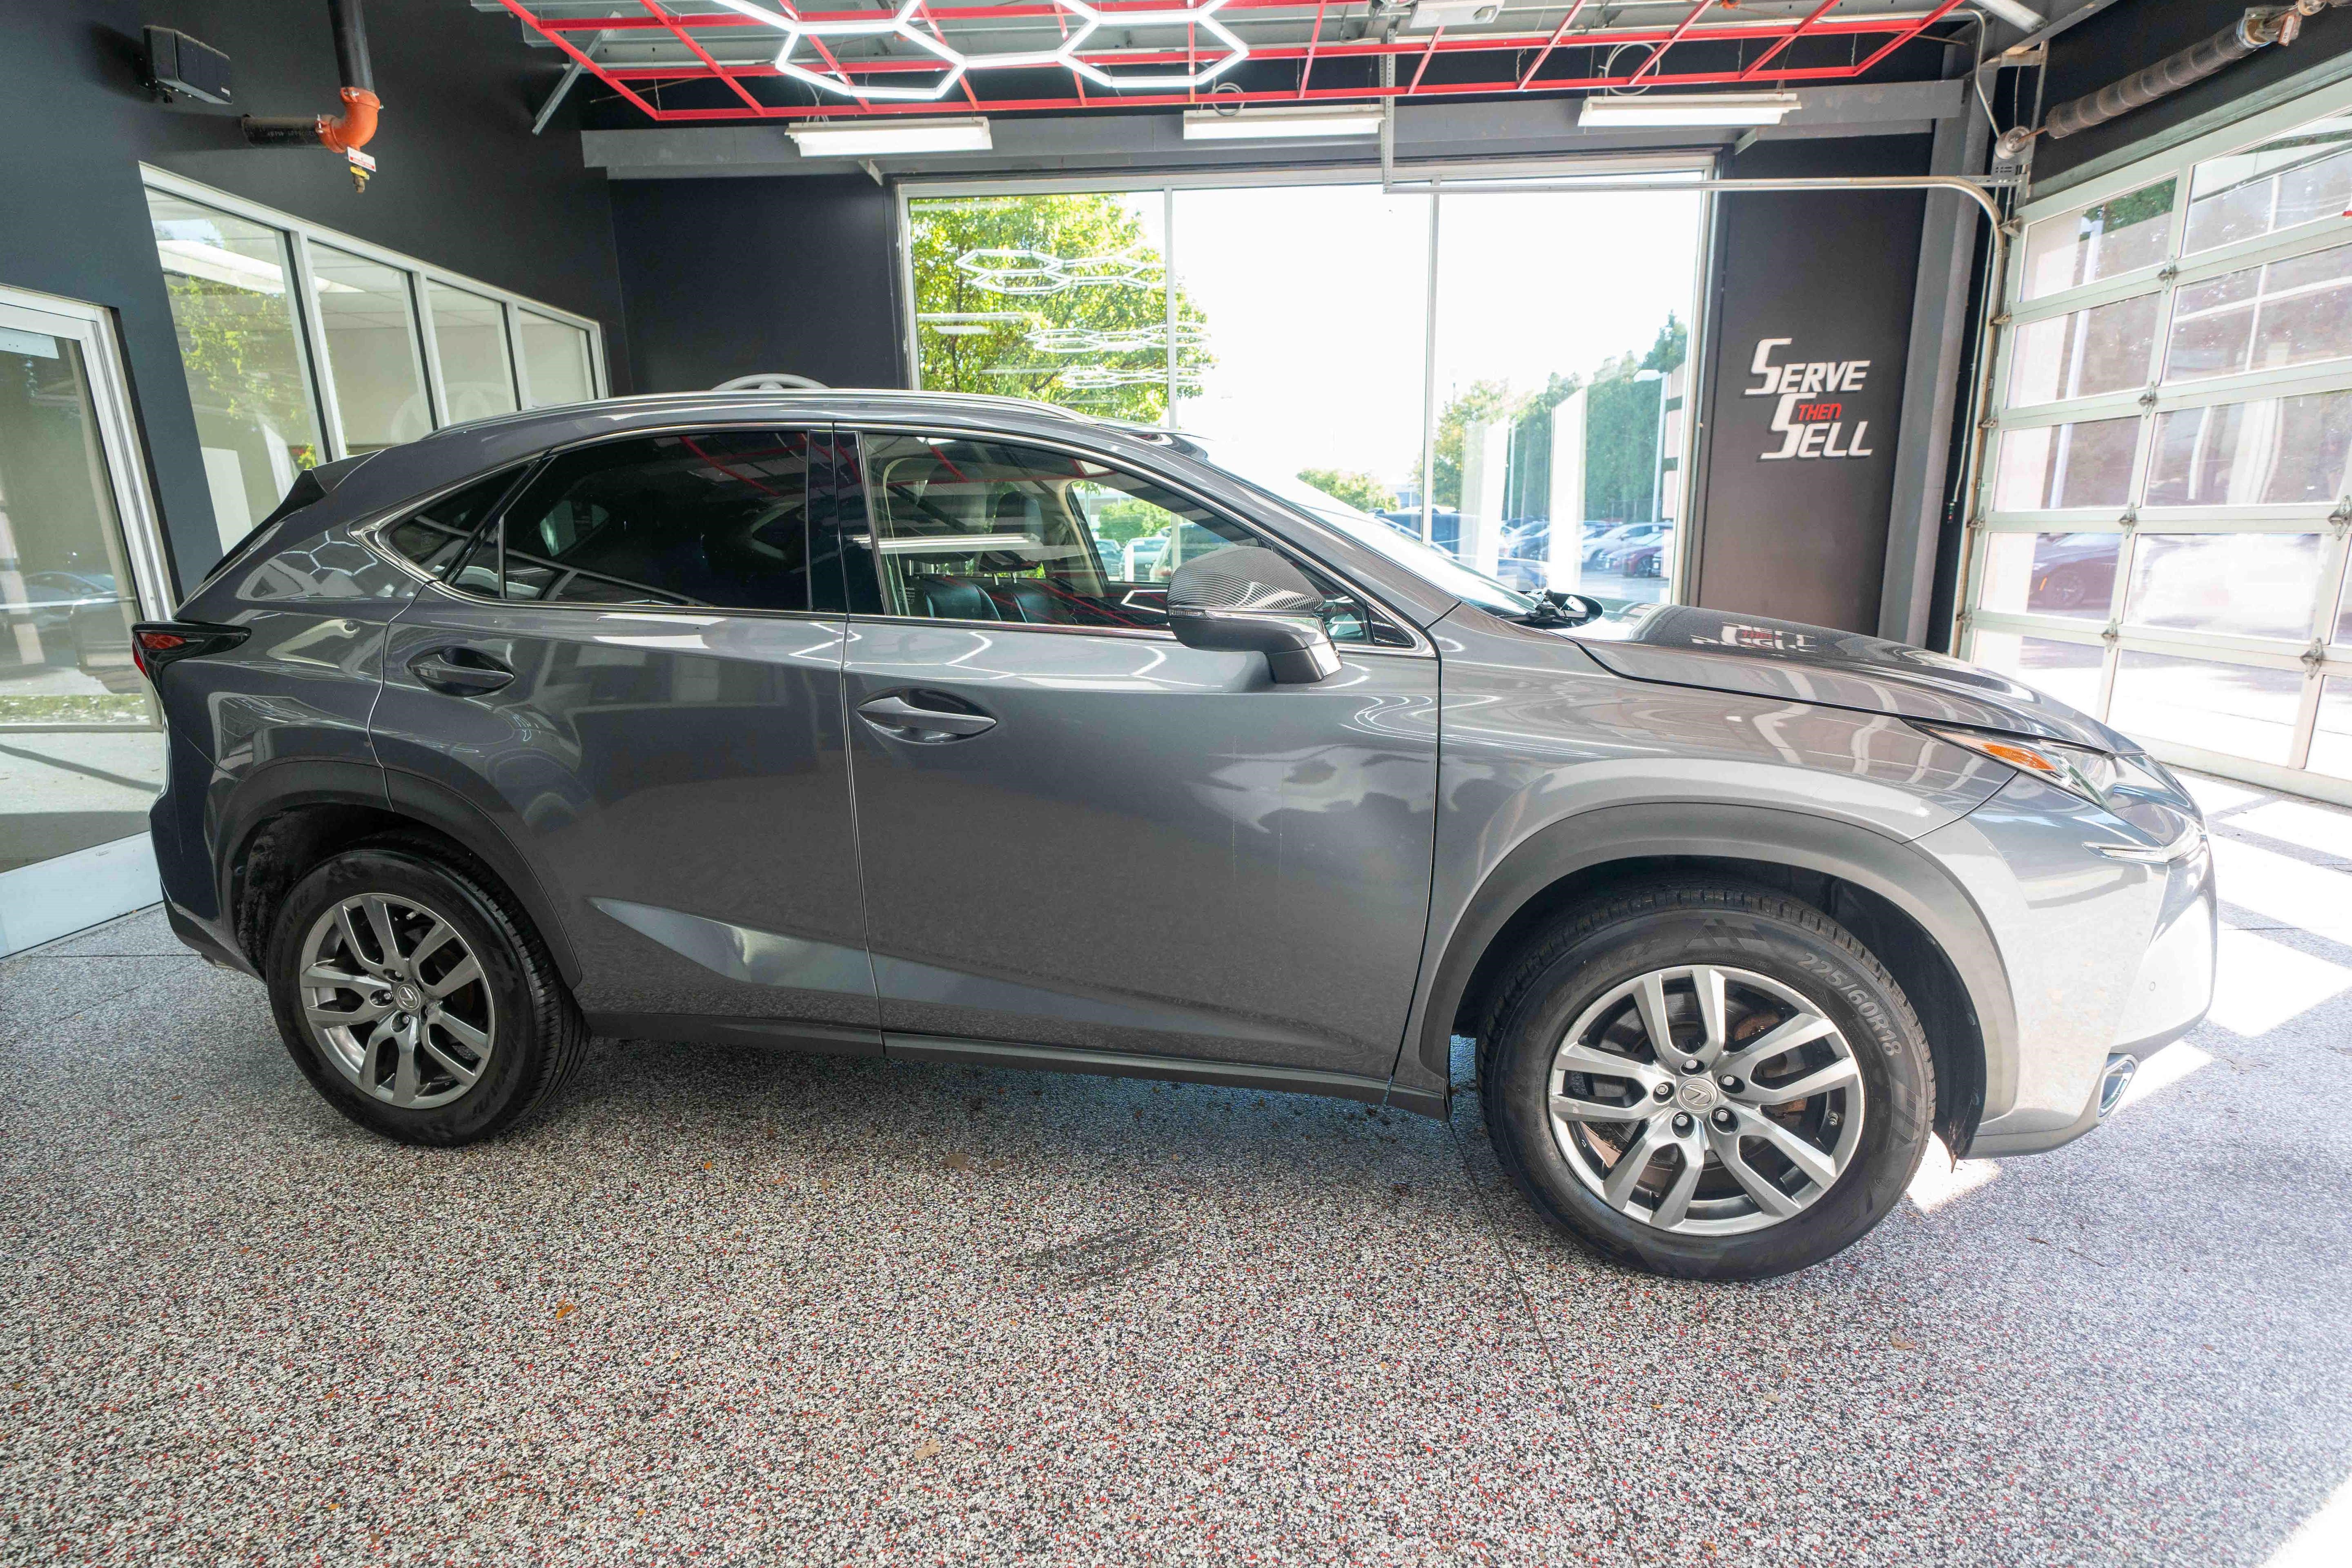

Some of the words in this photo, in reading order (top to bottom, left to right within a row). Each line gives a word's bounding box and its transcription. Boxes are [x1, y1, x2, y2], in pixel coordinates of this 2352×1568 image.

[1744, 338, 1871, 395] SERVE
[1760, 392, 1873, 459] SELL
[1798, 403, 1842, 421] THEN
[1797, 952, 1902, 1056] 225/60R18
